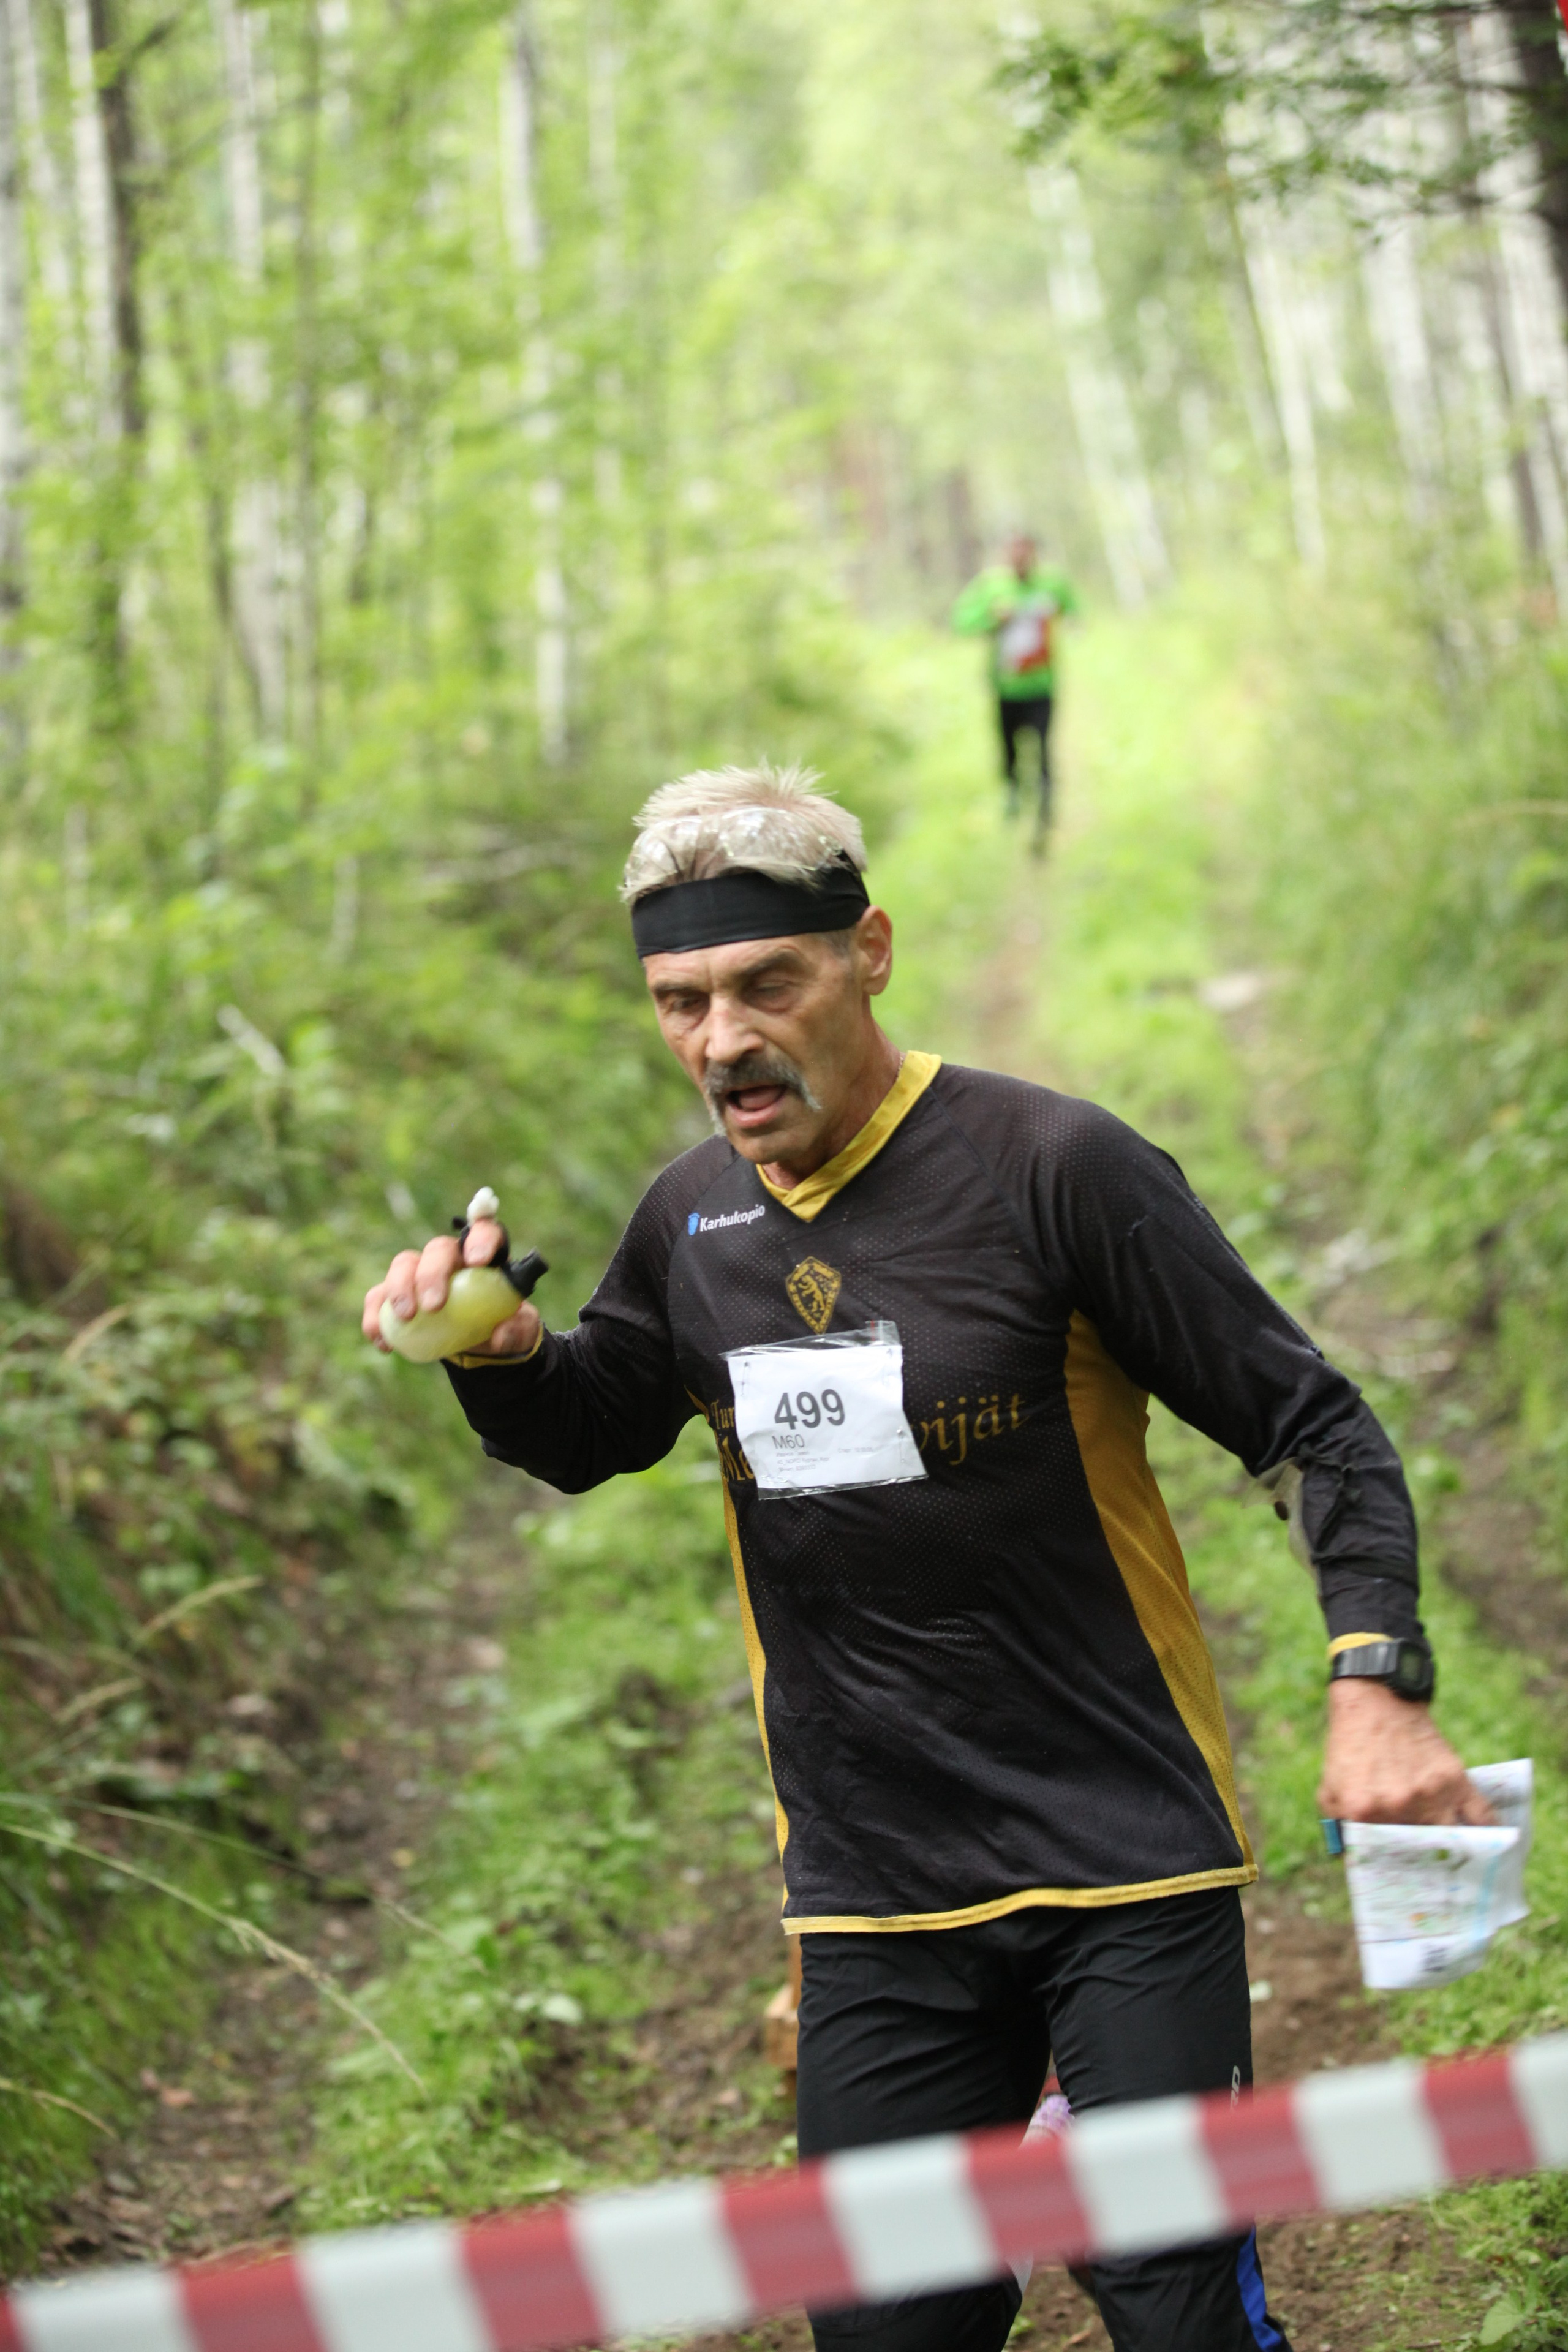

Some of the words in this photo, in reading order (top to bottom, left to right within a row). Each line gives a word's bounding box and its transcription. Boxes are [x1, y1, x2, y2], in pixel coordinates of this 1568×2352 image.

[699, 1204, 765, 1232] Karhukopio
[774, 1389, 845, 1430] 499
[772, 1434, 805, 1449] M60
